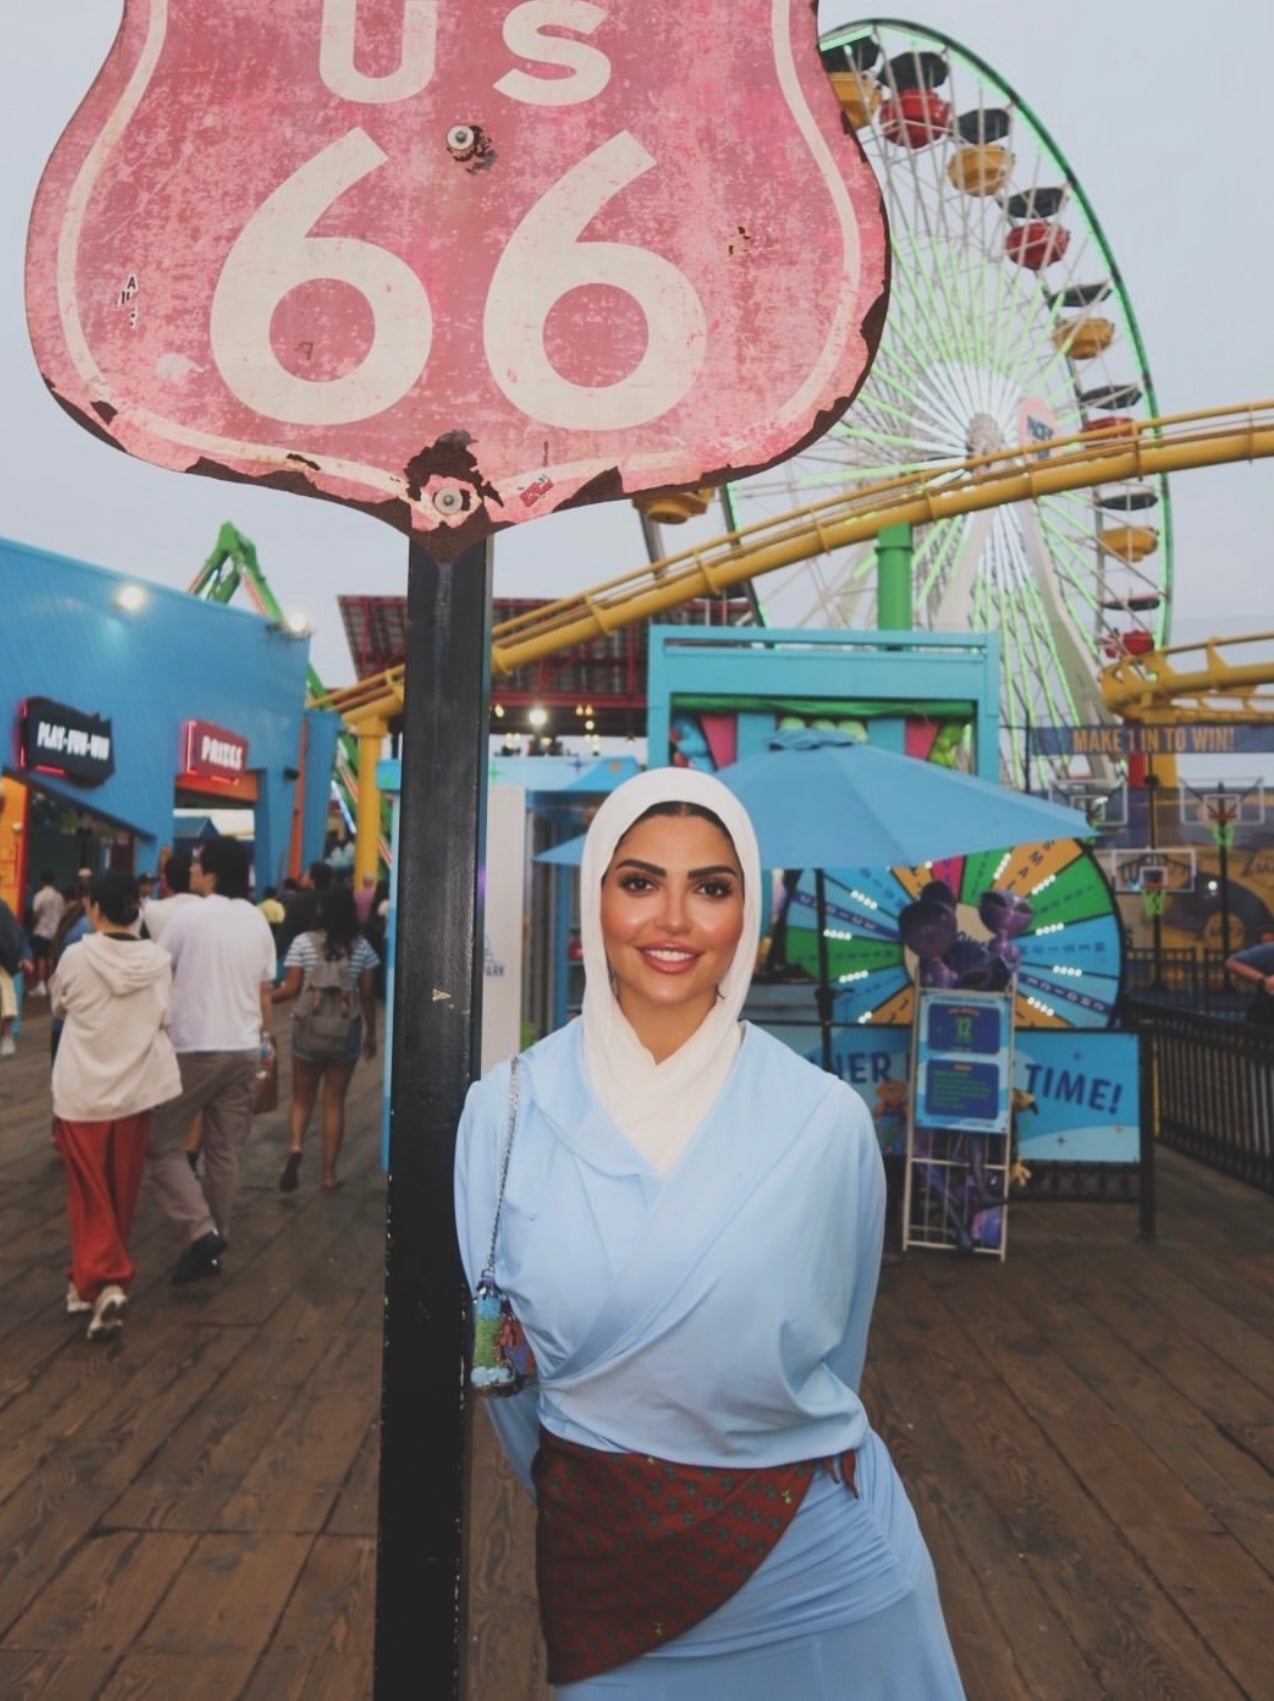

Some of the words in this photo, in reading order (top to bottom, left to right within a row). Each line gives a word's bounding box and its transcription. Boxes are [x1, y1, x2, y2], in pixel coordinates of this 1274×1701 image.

[209, 126, 707, 431] 66
[1073, 729, 1122, 752] MAKE
[1129, 729, 1136, 752] 1
[1141, 728, 1159, 752] IN
[1164, 728, 1186, 752] TO
[1191, 727, 1235, 752] WIN!
[1025, 1063, 1123, 1115] TIME!
